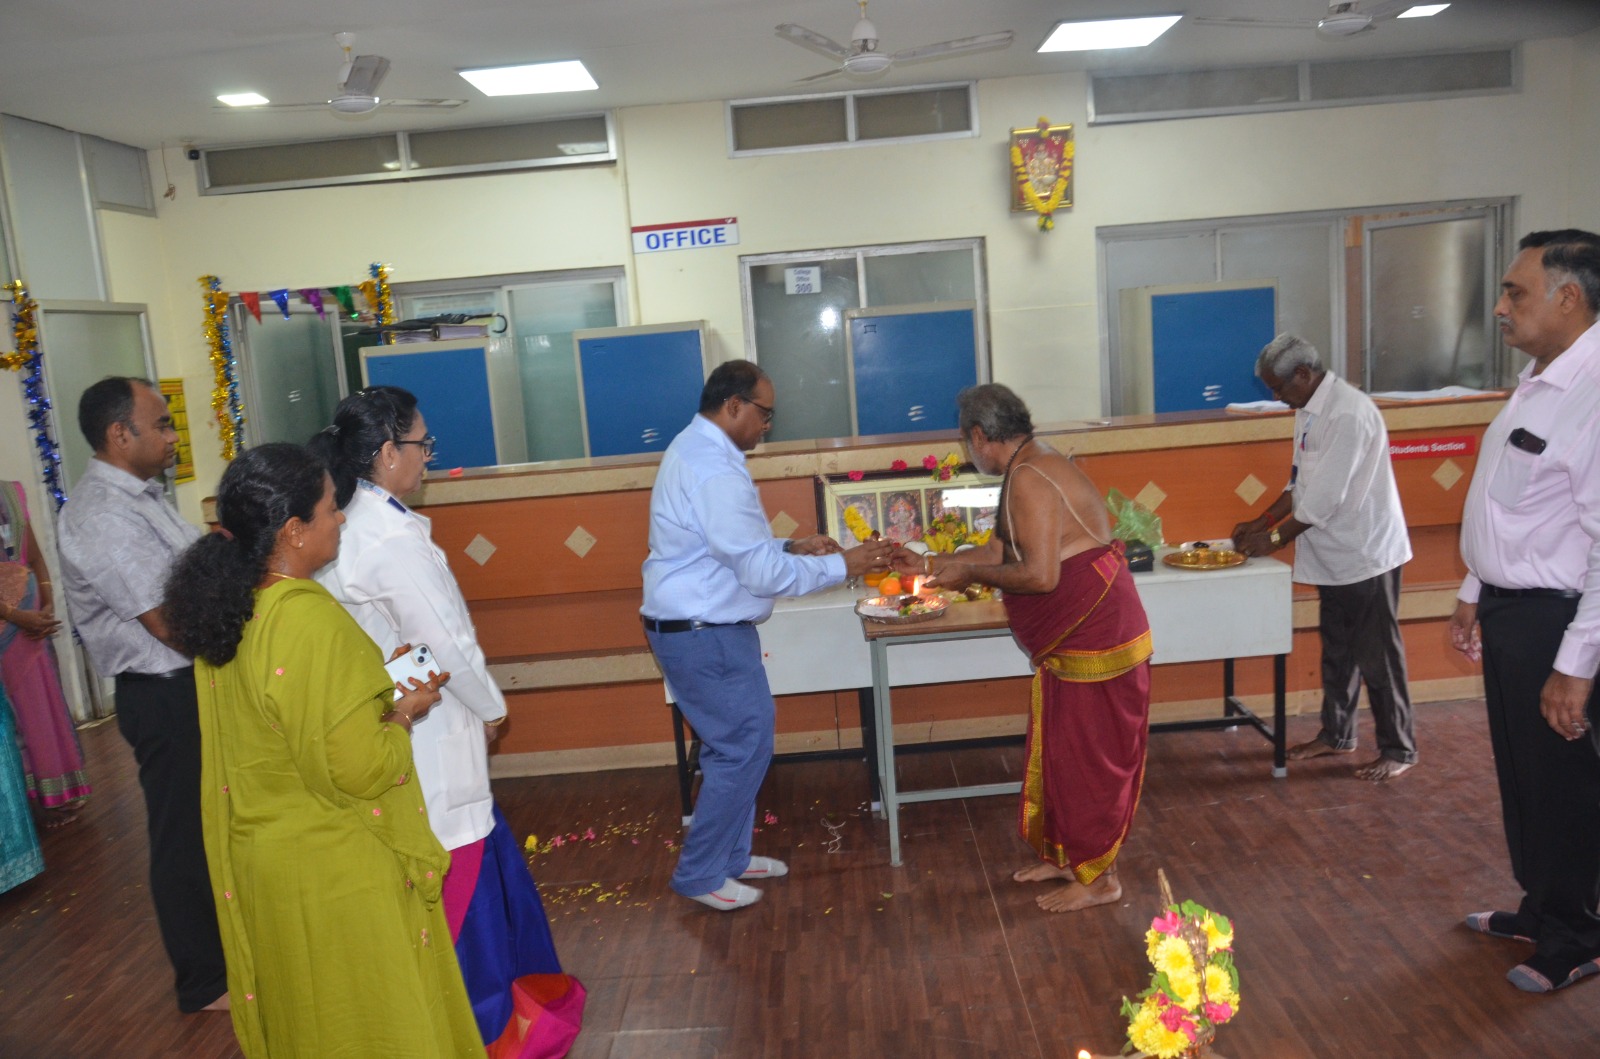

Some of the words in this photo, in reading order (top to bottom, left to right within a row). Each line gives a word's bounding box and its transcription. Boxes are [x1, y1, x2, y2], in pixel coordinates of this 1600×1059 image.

[646, 228, 726, 250] OFFICE
[1389, 445, 1430, 455] Students
[1431, 442, 1466, 452] Section
